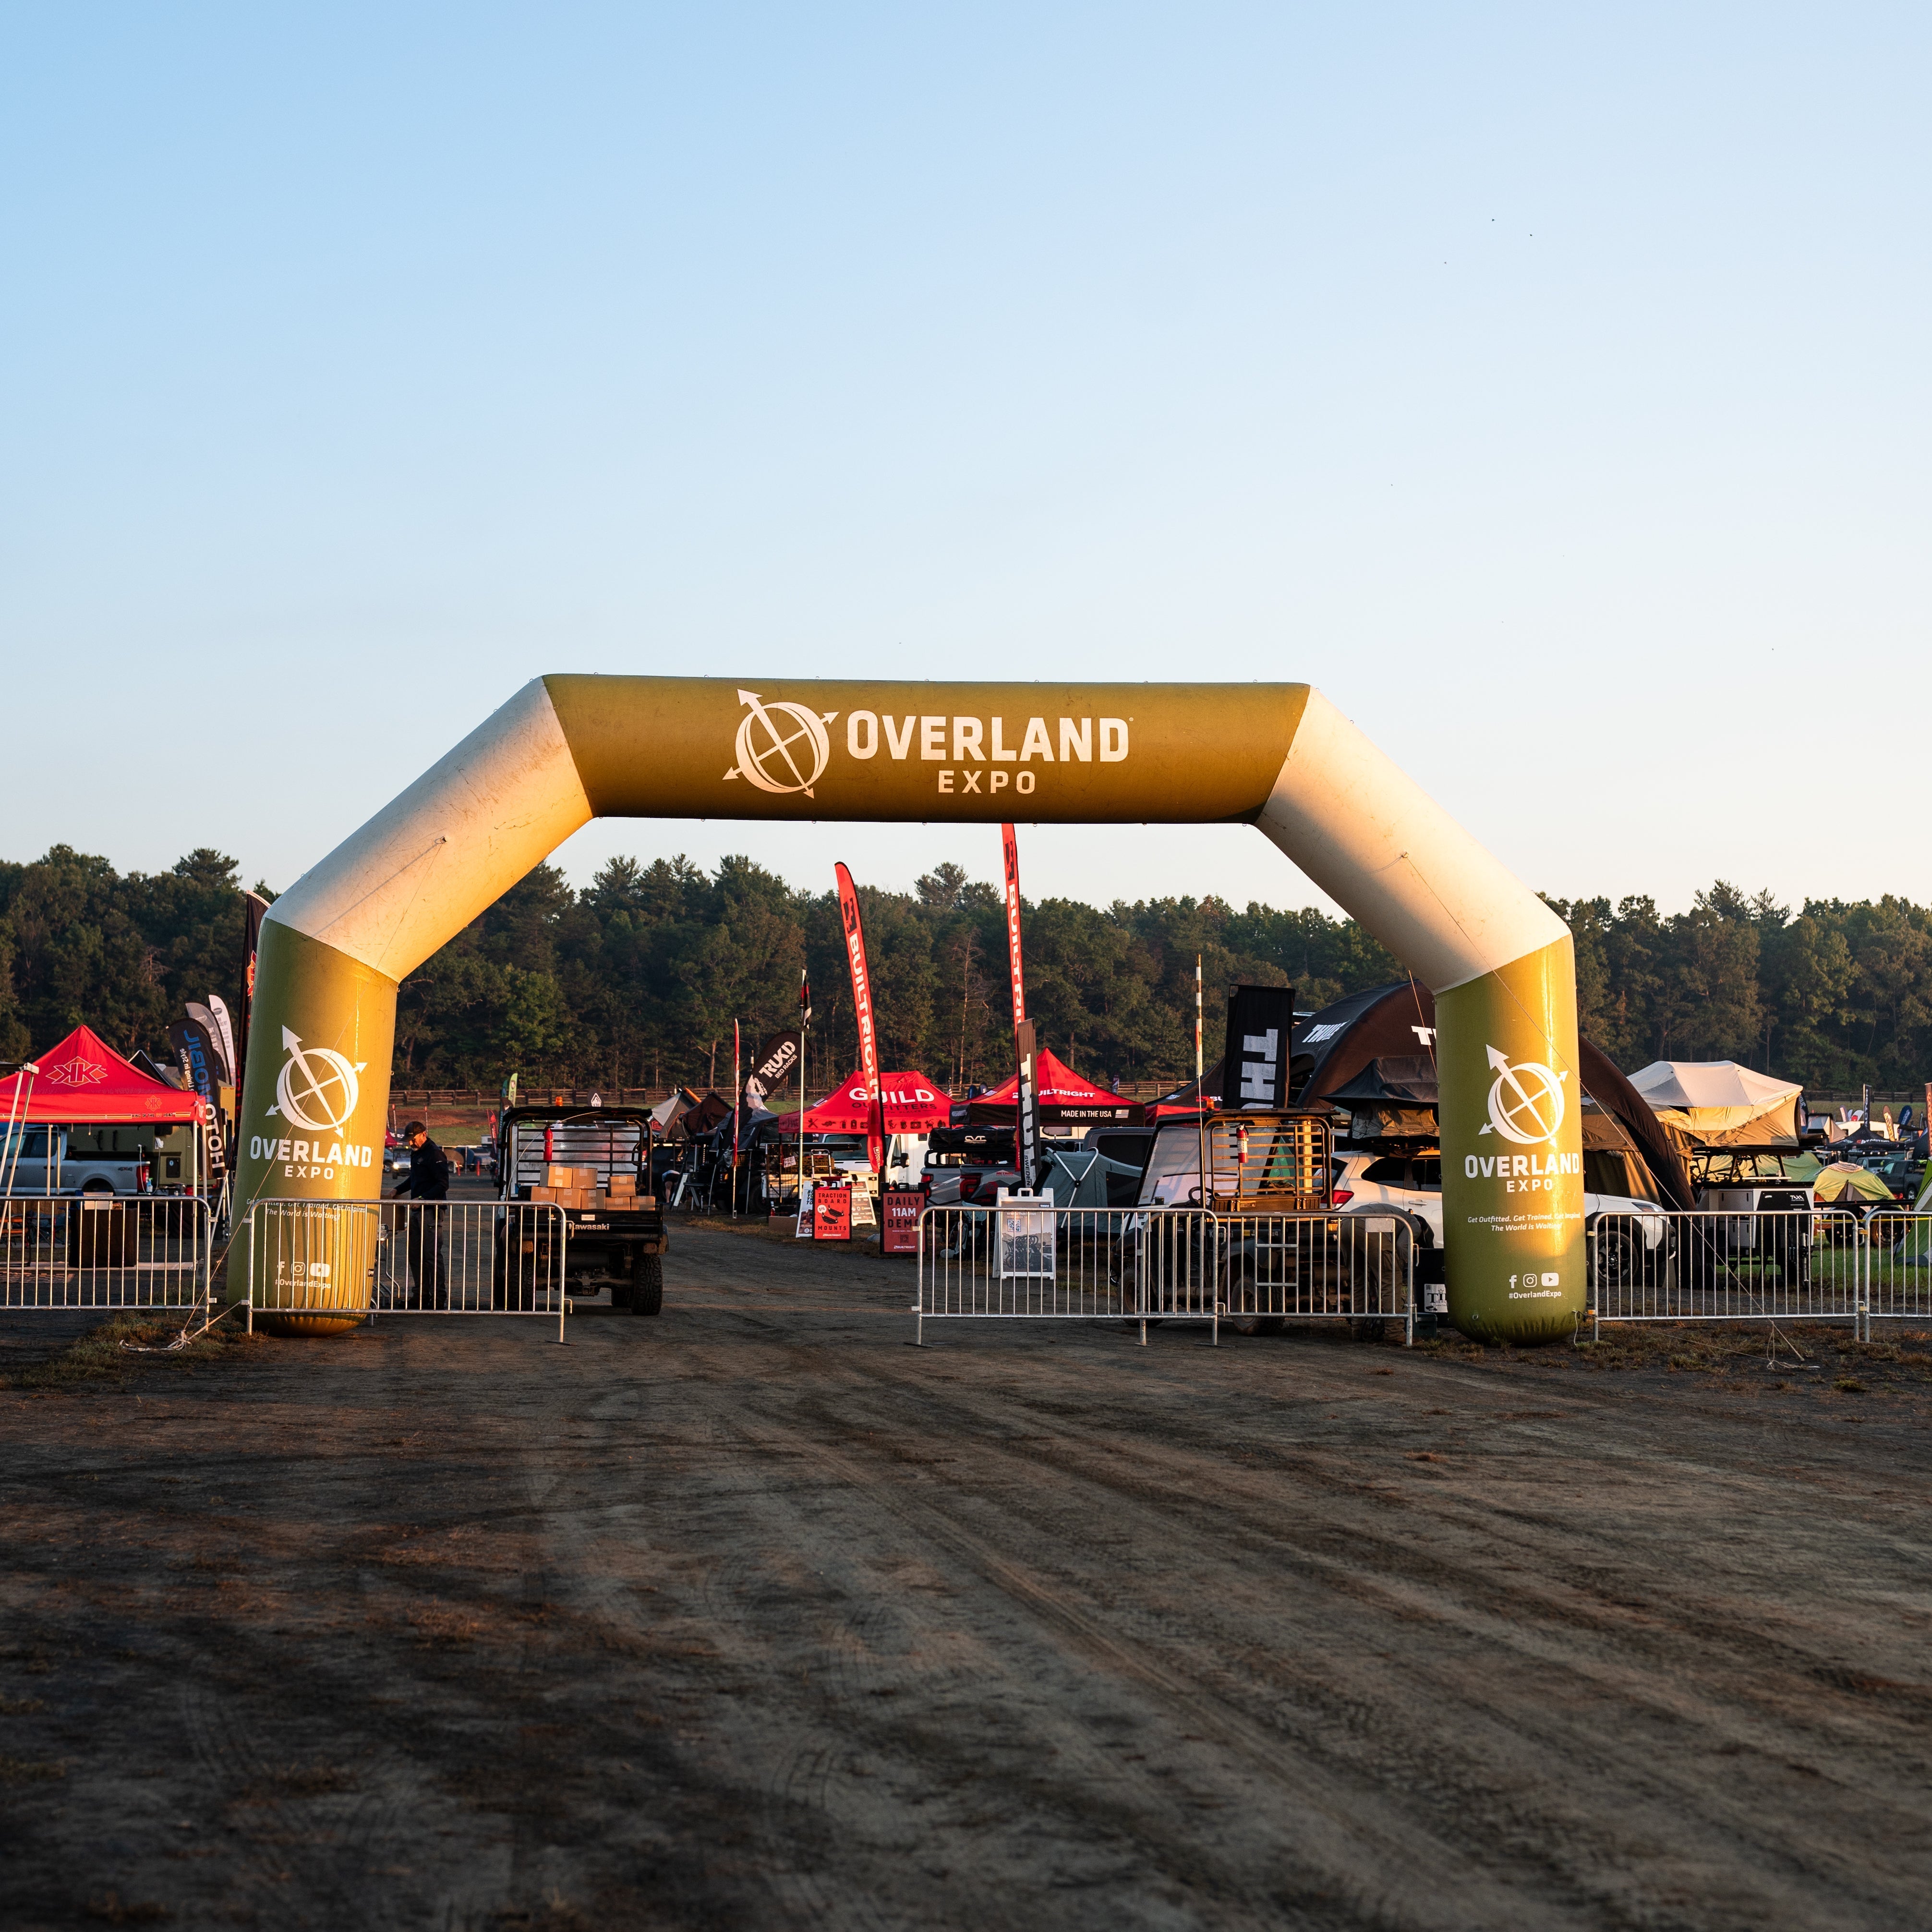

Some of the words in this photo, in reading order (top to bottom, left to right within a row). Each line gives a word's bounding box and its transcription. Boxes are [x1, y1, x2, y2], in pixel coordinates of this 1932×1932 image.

[847, 710, 1129, 762] OVERLAND
[938, 770, 1036, 794] EXPO
[775, 1069, 785, 1078] BED
[783, 1054, 797, 1070] RACKS
[250, 1135, 372, 1168] OVERLAND
[285, 1165, 334, 1180] EXPO
[1465, 1153, 1580, 1178] OVERLAND
[1507, 1179, 1553, 1193] EXPO
[887, 1197, 920, 1206] DAILY
[892, 1208, 916, 1217] 11AM
[1509, 1290, 1562, 1299] #OverlandExpo
